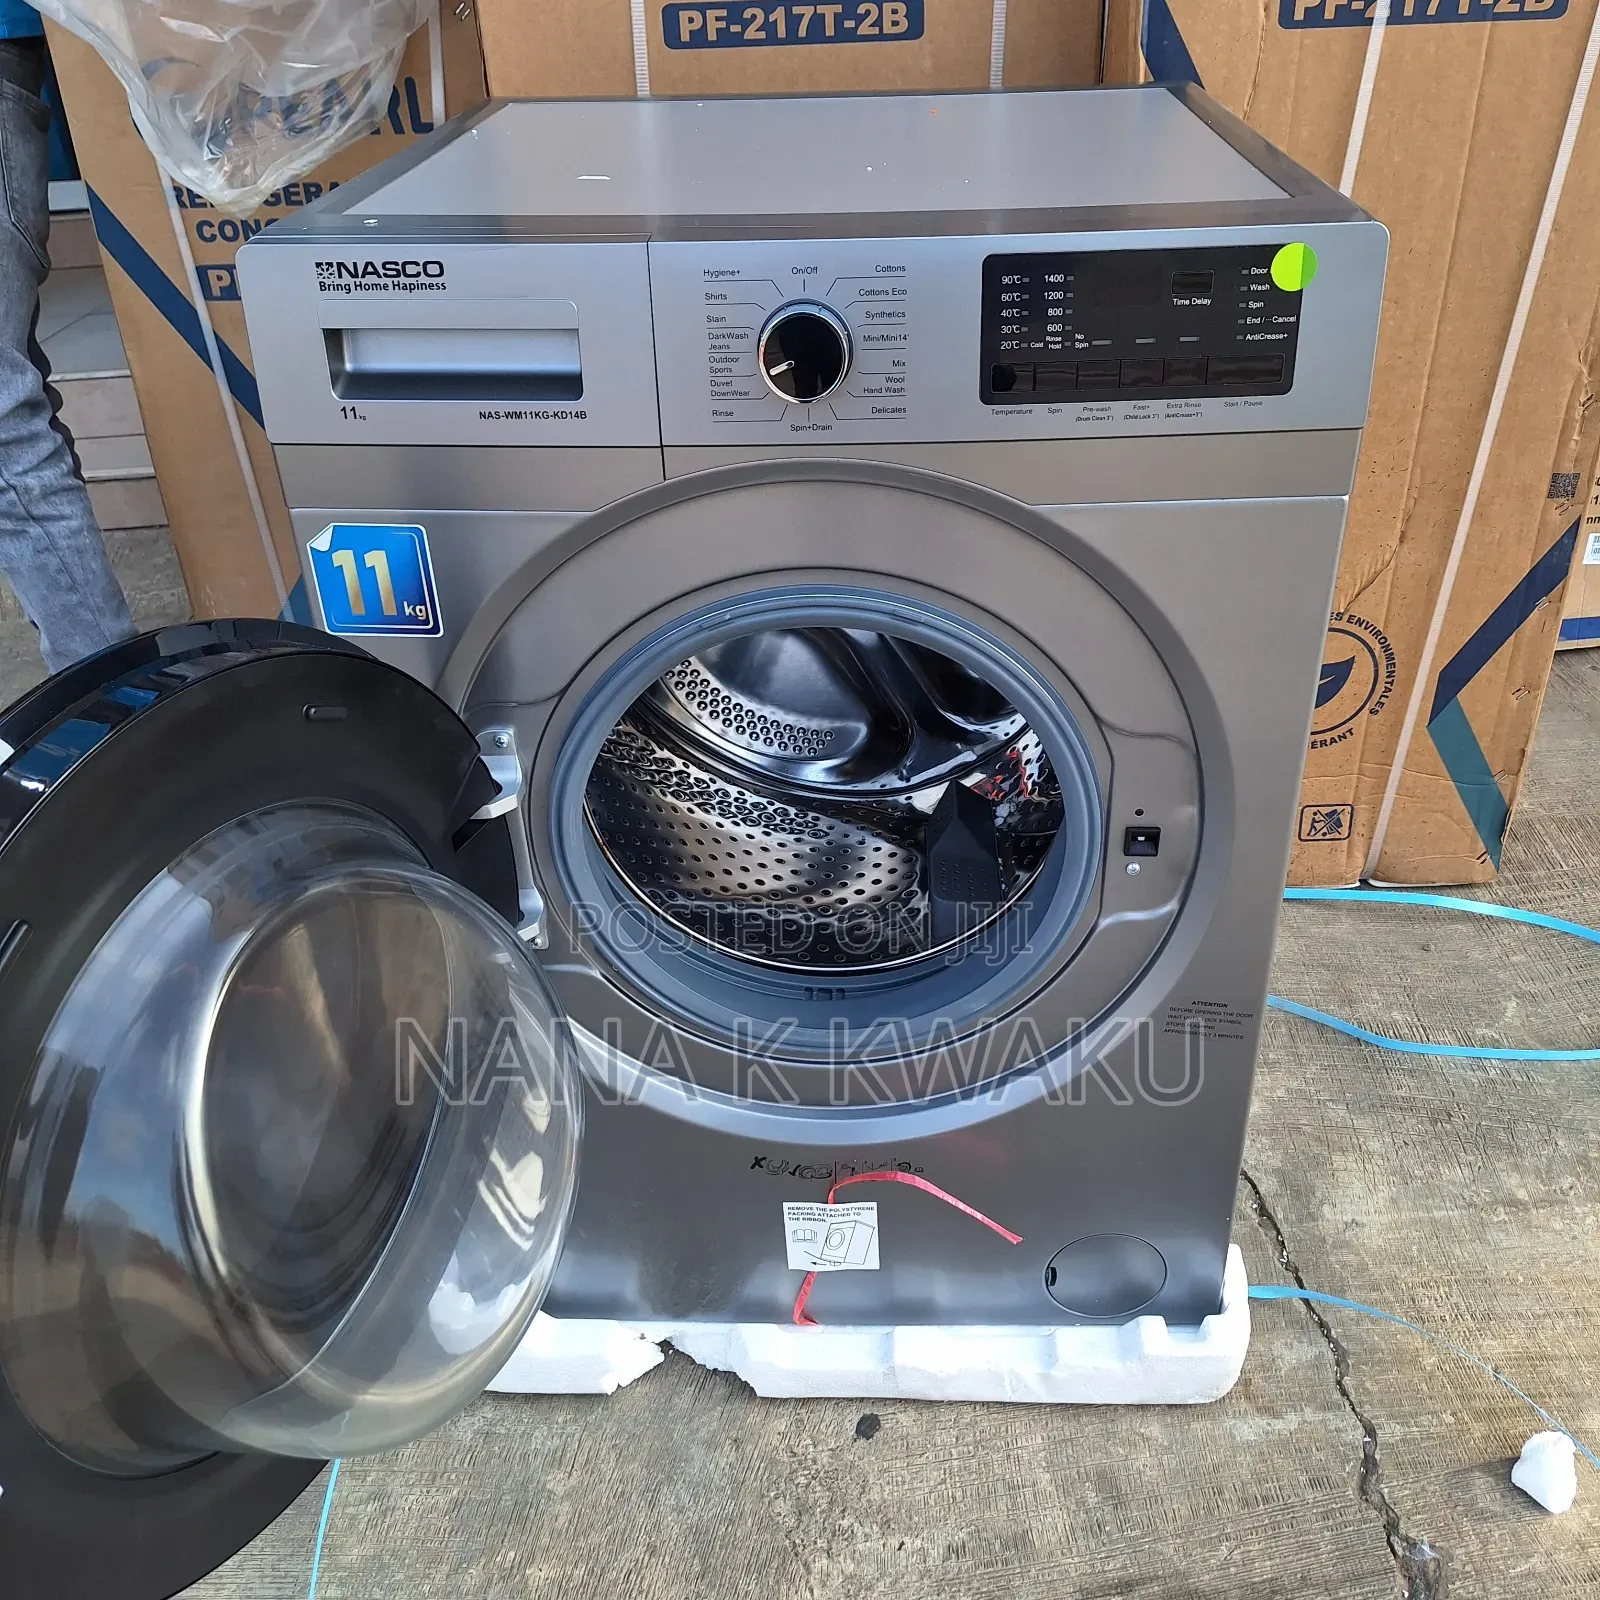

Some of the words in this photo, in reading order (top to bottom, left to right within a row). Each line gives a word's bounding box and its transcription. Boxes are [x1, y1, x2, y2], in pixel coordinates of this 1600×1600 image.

[678, 2, 908, 42] PF-217T-2B
[336, 261, 444, 279] NASCO
[791, 266, 818, 275] On/Off
[875, 264, 906, 272] Cottons
[703, 269, 740, 278] Hygiene+
[1044, 274, 1064, 282] 1400
[319, 281, 352, 294] Bring
[354, 280, 389, 291] Home
[392, 280, 446, 293] Hapiness
[704, 292, 728, 300] Shirts
[858, 288, 889, 296] Cottons
[892, 288, 908, 296] Eco
[1044, 292, 1064, 300] 1200
[1172, 298, 1190, 306] Time
[1192, 298, 1212, 306] Delay
[1248, 301, 1264, 309] Spin
[865, 310, 906, 320] Synthetics
[1048, 308, 1063, 316] 800
[706, 315, 726, 323] Stain
[1246, 316, 1260, 324] End
[1047, 324, 1062, 332] 600
[708, 332, 748, 340] DarkWash
[708, 356, 740, 364] Outdoor
[892, 360, 906, 368] Mix
[710, 366, 732, 374] Sports
[885, 376, 905, 384] Wool
[863, 386, 882, 394] Hand
[884, 386, 906, 394] Wash
[340, 406, 358, 420] 11
[871, 406, 907, 414] Delicates
[991, 408, 1033, 416] Temperature
[479, 411, 587, 420] NAS-WM11KG-KD14B
[790, 424, 832, 432] Spin+Drain
[332, 549, 397, 616] 11
[404, 601, 427, 620] kg
[1346, 614, 1396, 716] ENVIRONMENTALES
[1308, 728, 1354, 749] ÉRANT
[1192, 1000, 1229, 1008] ATTENTION
